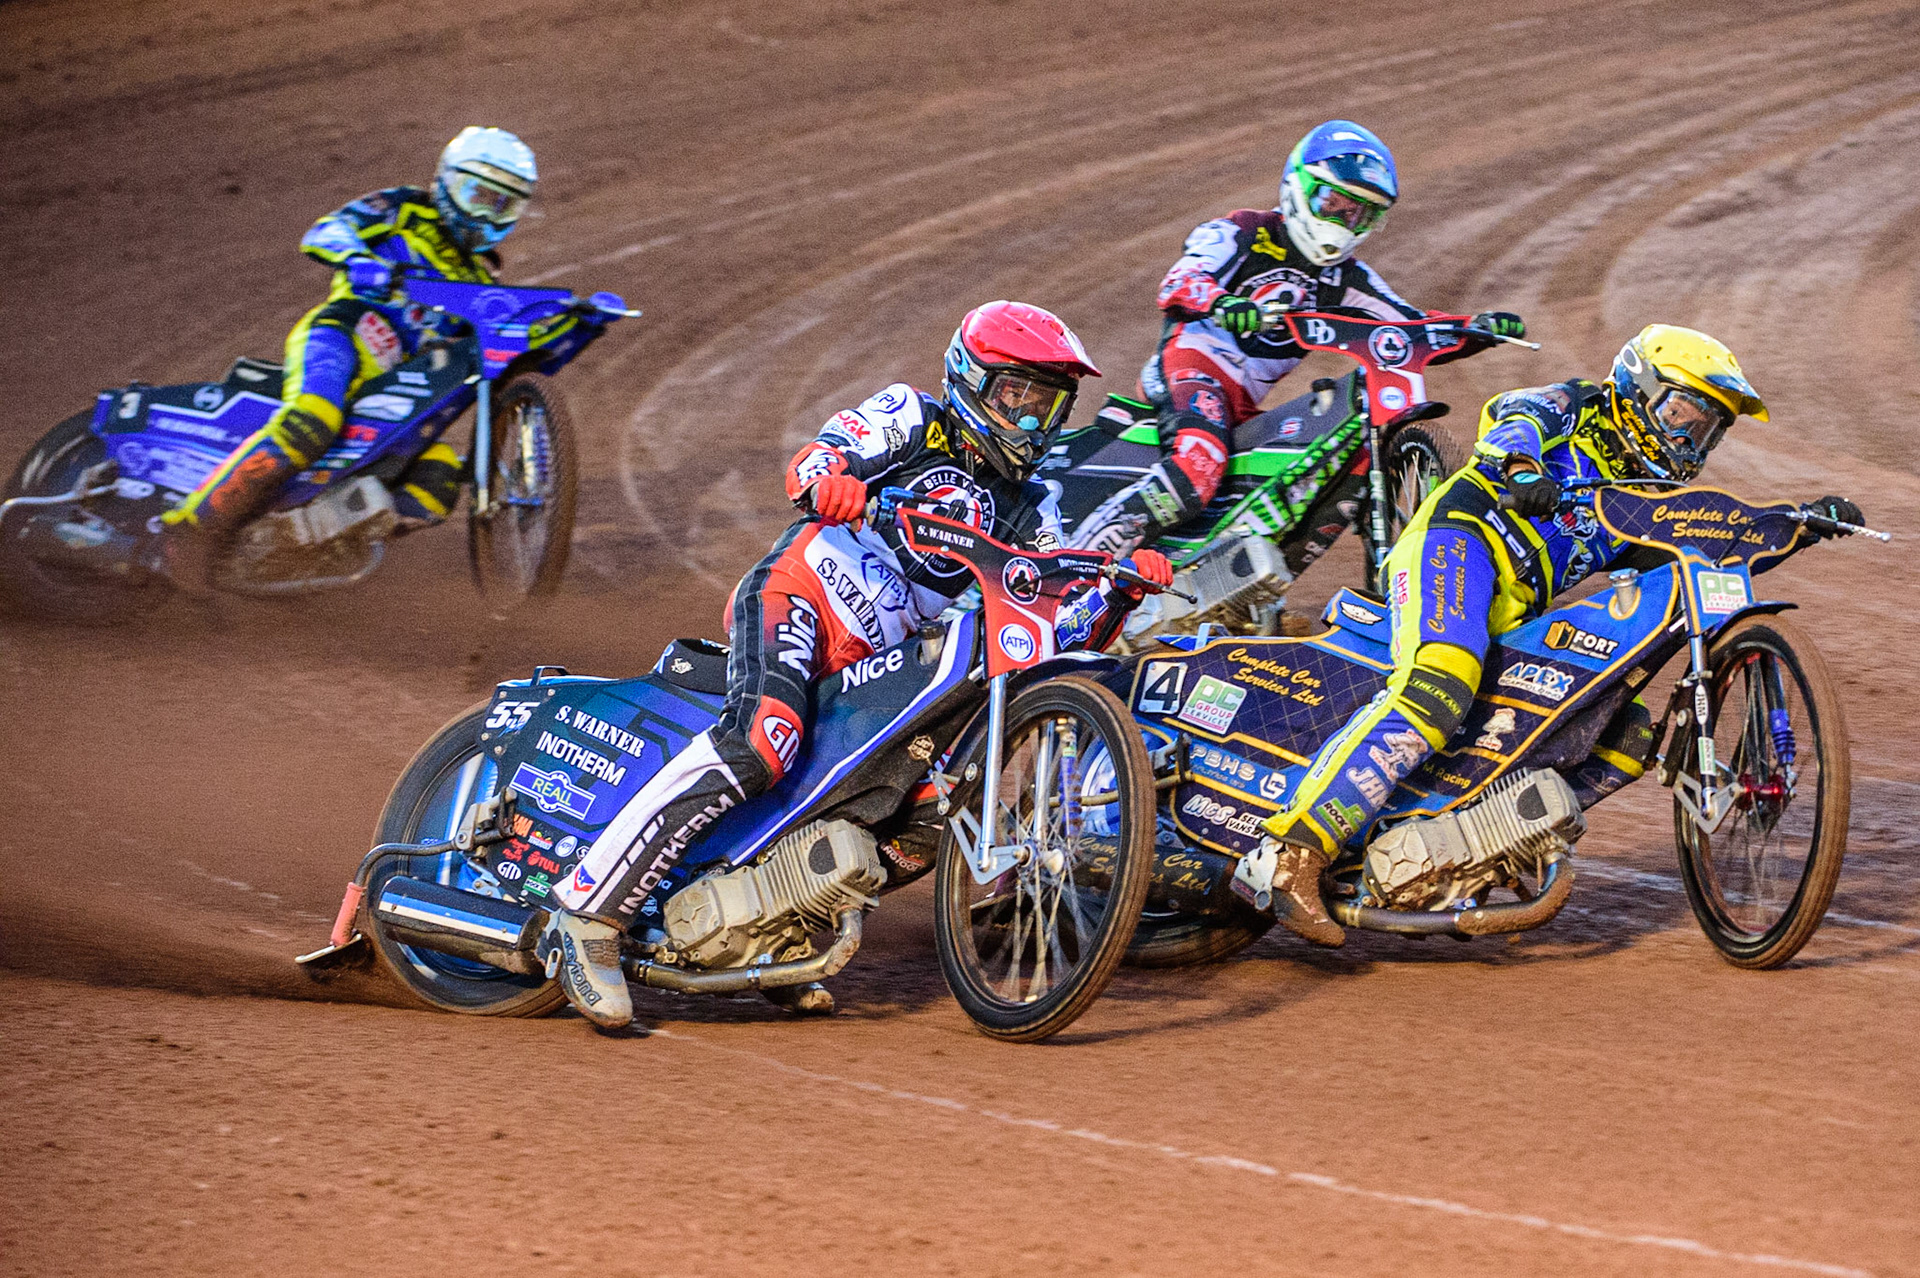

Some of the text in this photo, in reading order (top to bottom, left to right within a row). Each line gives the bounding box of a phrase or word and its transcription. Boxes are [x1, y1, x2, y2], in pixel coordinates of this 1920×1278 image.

[923, 473, 958, 490] BELLE
[1652, 504, 1723, 524] Complete
[917, 525, 976, 549] S. WARNER
[1672, 523, 1765, 546] Services Ltd
[817, 557, 838, 586] S.
[1450, 536, 1468, 621] Services Ltd
[1397, 571, 1409, 605] AHS
[1428, 544, 1447, 634] Complete Car
[1699, 573, 1744, 602] PC
[1006, 635, 1031, 651] ATPI
[1573, 629, 1619, 655] FORT
[841, 649, 904, 694] Nice
[1227, 648, 1322, 689] Complete Car
[1504, 663, 1573, 694] APEX
[1144, 665, 1180, 711] 4
[1187, 678, 1245, 712] PC
[1233, 667, 1325, 707] Services Ltd
[486, 701, 540, 731] 55
[1184, 707, 1230, 729] SERVICES
[1196, 702, 1233, 720] GROUP
[555, 704, 646, 759] S. WARNER
[536, 731, 627, 788] INOTHERM
[1190, 744, 1256, 781] PBHS
[531, 777, 572, 807] REALL
[1229, 820, 1253, 833] VANS
[1324, 802, 1348, 829] ROCK
[618, 793, 736, 917] INOTHERM
[563, 931, 602, 1006] daytona
